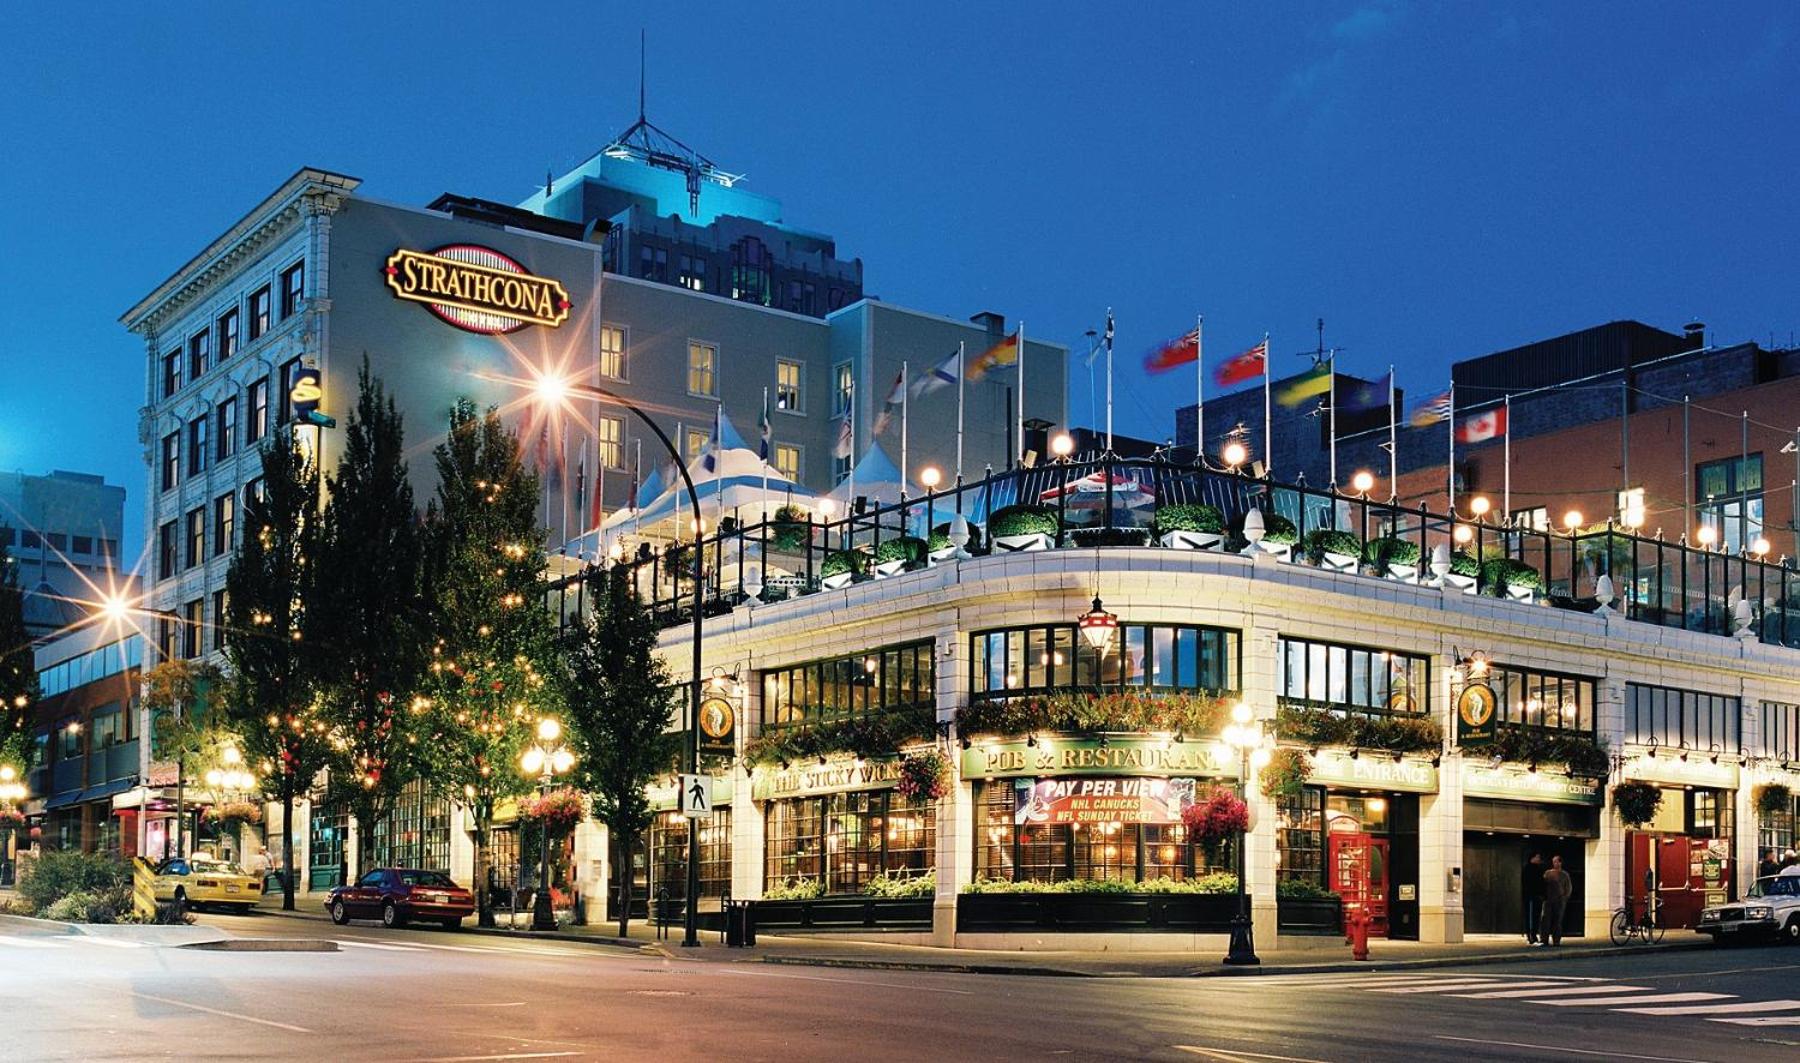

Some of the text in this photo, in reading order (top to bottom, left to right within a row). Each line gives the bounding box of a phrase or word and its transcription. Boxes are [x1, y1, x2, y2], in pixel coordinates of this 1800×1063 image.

[404, 256, 554, 318] STRATHCONA
[984, 751, 1026, 772] PUB
[1035, 753, 1056, 770] &
[774, 773, 801, 793] THE
[805, 766, 854, 788] STICKY
[1353, 763, 1430, 785] ENTRANCE
[1044, 779, 1166, 797] PAY PER VIEW
[1569, 784, 1597, 796] CENTRE
[1070, 799, 1141, 810] NHL CANUCKS
[1056, 811, 1153, 822] NFL SUNDAY TICKET
